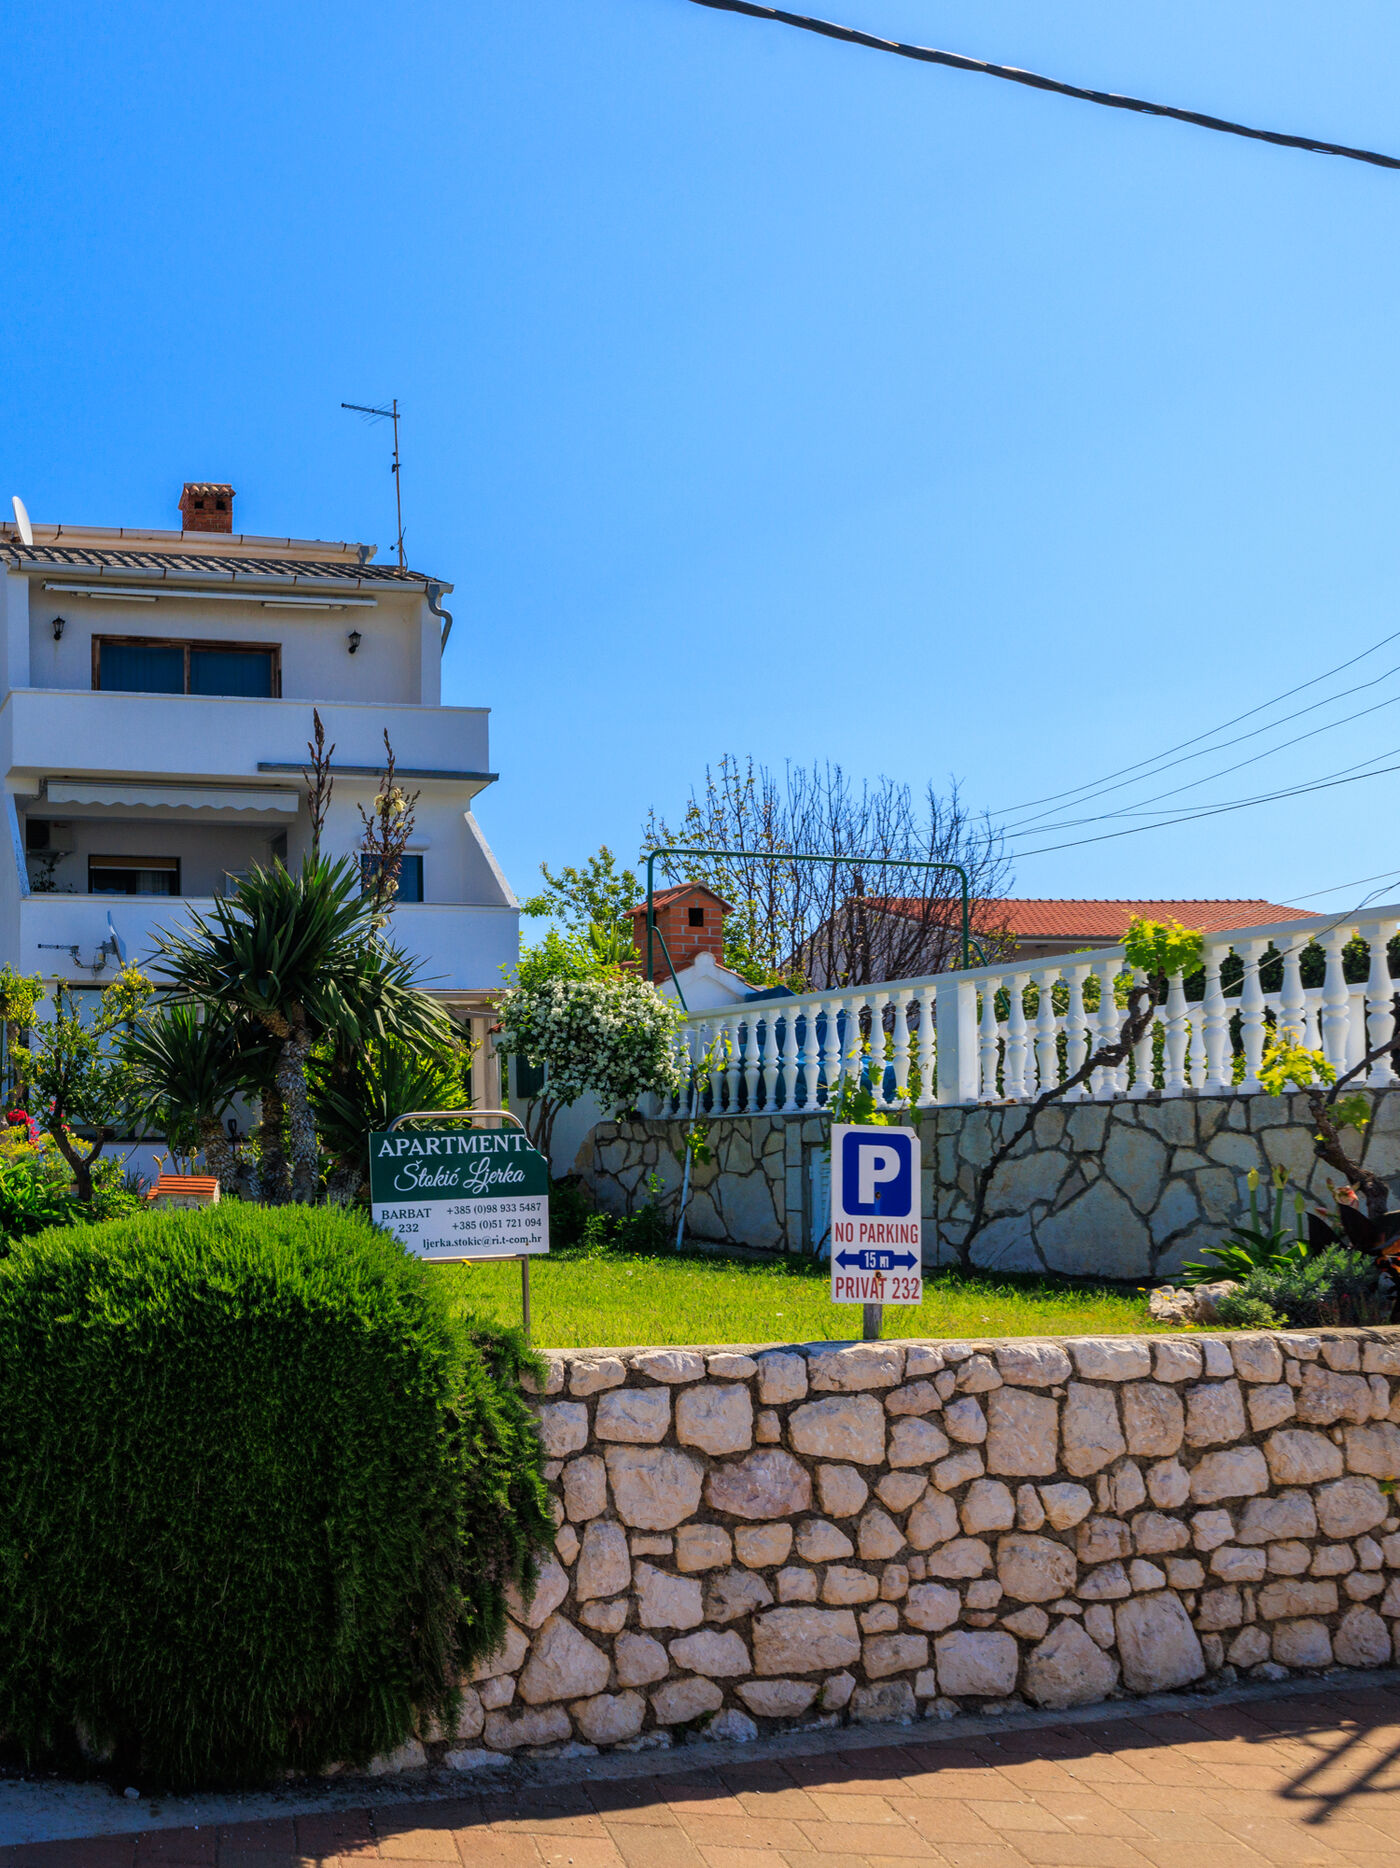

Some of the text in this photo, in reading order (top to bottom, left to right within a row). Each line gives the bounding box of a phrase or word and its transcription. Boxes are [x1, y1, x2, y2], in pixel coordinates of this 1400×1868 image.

[393, 1156, 526, 1195] Štokić Ljerka
[858, 1144, 901, 1204] P
[381, 1207, 432, 1221] BARBAT
[446, 1202, 542, 1216] +385 (0)98 933 5487
[397, 1222, 420, 1234] 232
[452, 1217, 542, 1231] +385 (0)51 721 094
[422, 1232, 543, 1251] ljerka.stokic@ri.t-com.hr
[834, 1222, 919, 1245] NO PARKING
[864, 1251, 890, 1269] 15 m
[834, 1276, 921, 1300] PRIVAT 232
